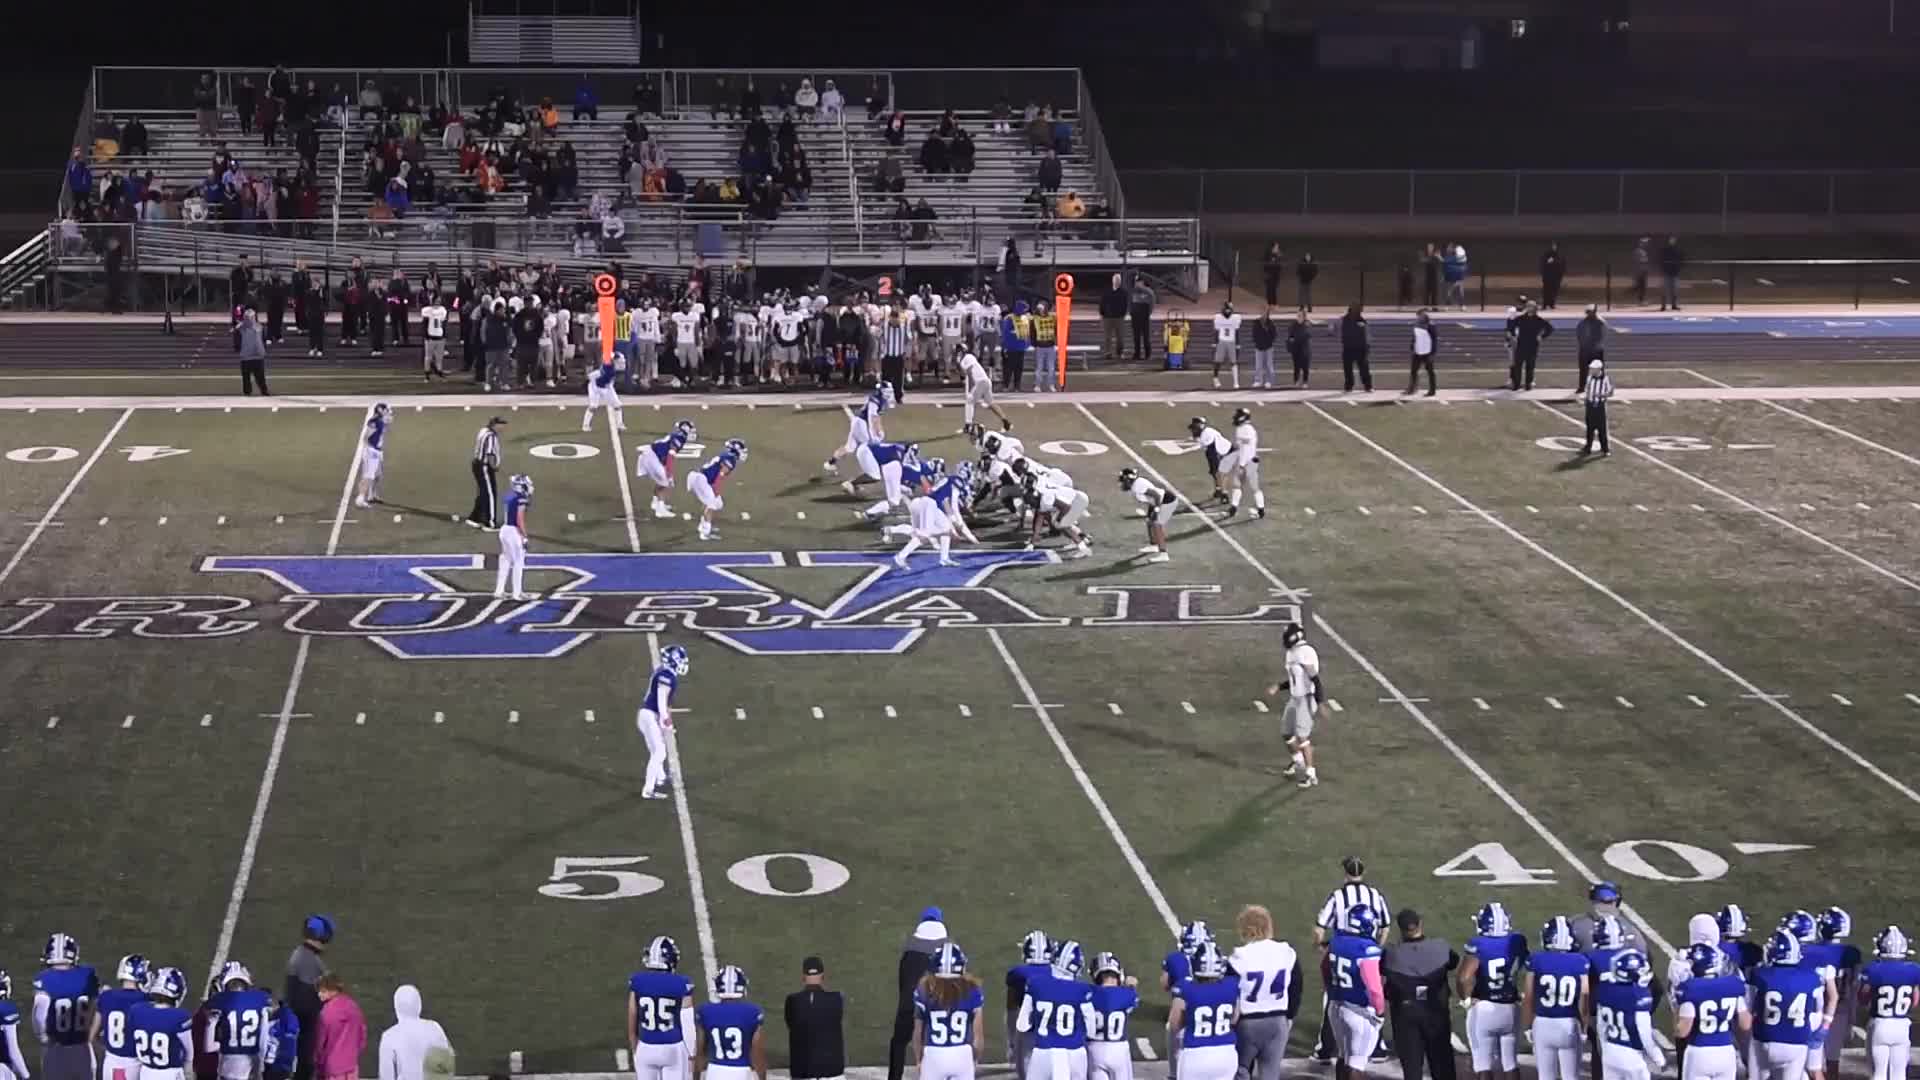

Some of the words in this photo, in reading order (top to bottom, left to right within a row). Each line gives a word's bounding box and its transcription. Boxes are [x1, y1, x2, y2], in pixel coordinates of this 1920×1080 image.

[878, 276, 892, 295] 2
[0, 584, 1302, 640] RURAL
[1245, 967, 1287, 1004] 74
[1487, 957, 1506, 989] 5
[1539, 973, 1577, 1008] 30
[638, 996, 677, 1032] 35
[1035, 1000, 1076, 1037] 70
[1699, 997, 1738, 1034] 67
[1764, 990, 1808, 1028] 64
[1877, 984, 1913, 1017] 26
[107, 1010, 126, 1049] 8
[226, 1008, 260, 1047] 12
[929, 1010, 969, 1045] 59
[1193, 1003, 1234, 1038] 66
[133, 1028, 170, 1067] 29
[711, 1026, 743, 1060] 13
